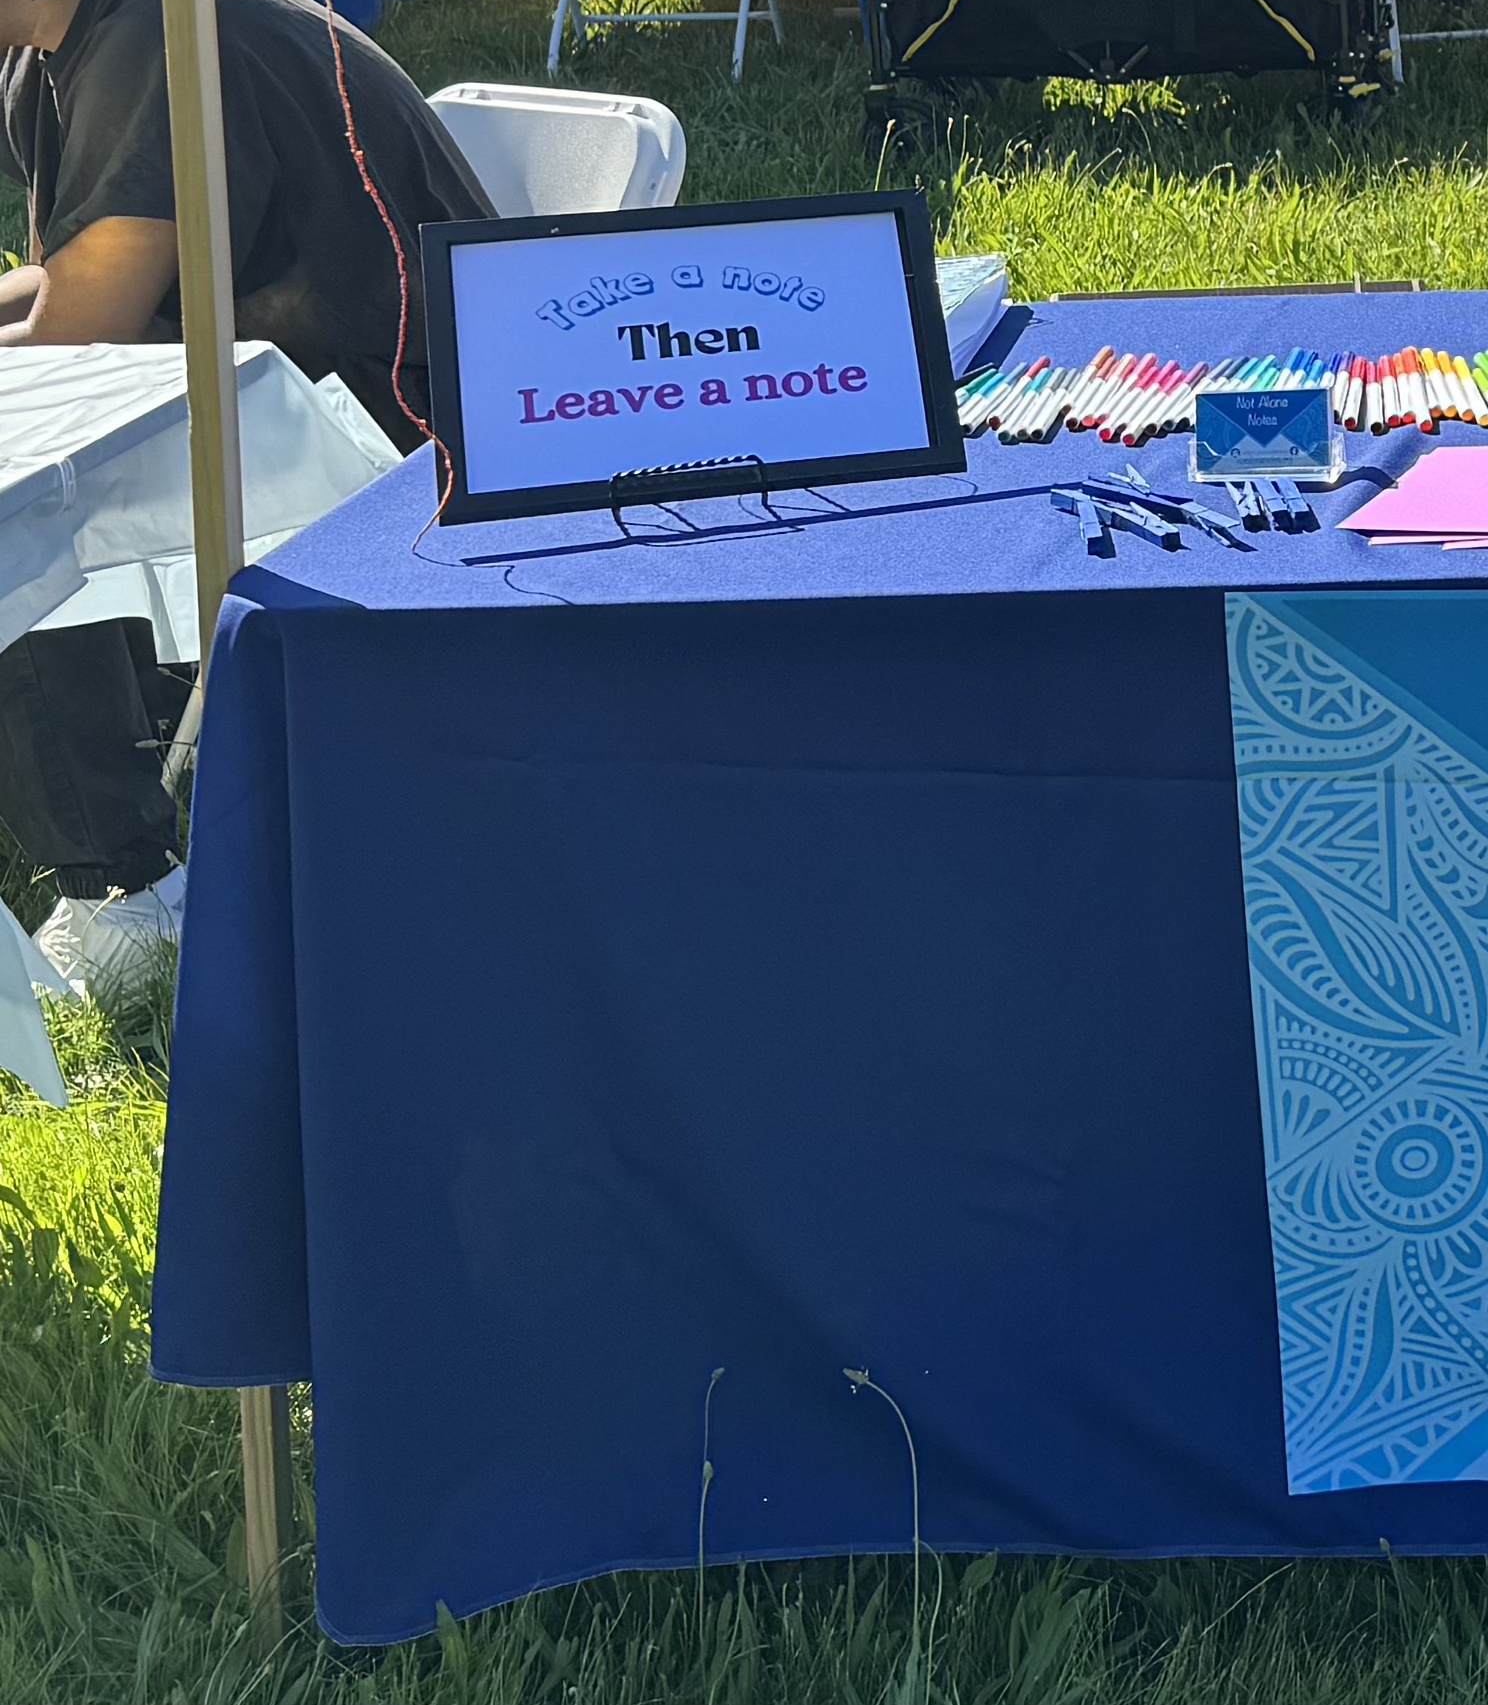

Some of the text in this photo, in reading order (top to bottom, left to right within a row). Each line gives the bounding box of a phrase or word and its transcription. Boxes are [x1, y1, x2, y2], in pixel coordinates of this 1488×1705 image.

[534, 264, 827, 331] Take a note
[617, 321, 761, 362] Then
[517, 362, 868, 425] Leave a note
[1236, 395, 1289, 409] Not Alone
[1247, 413, 1278, 427] Notes
